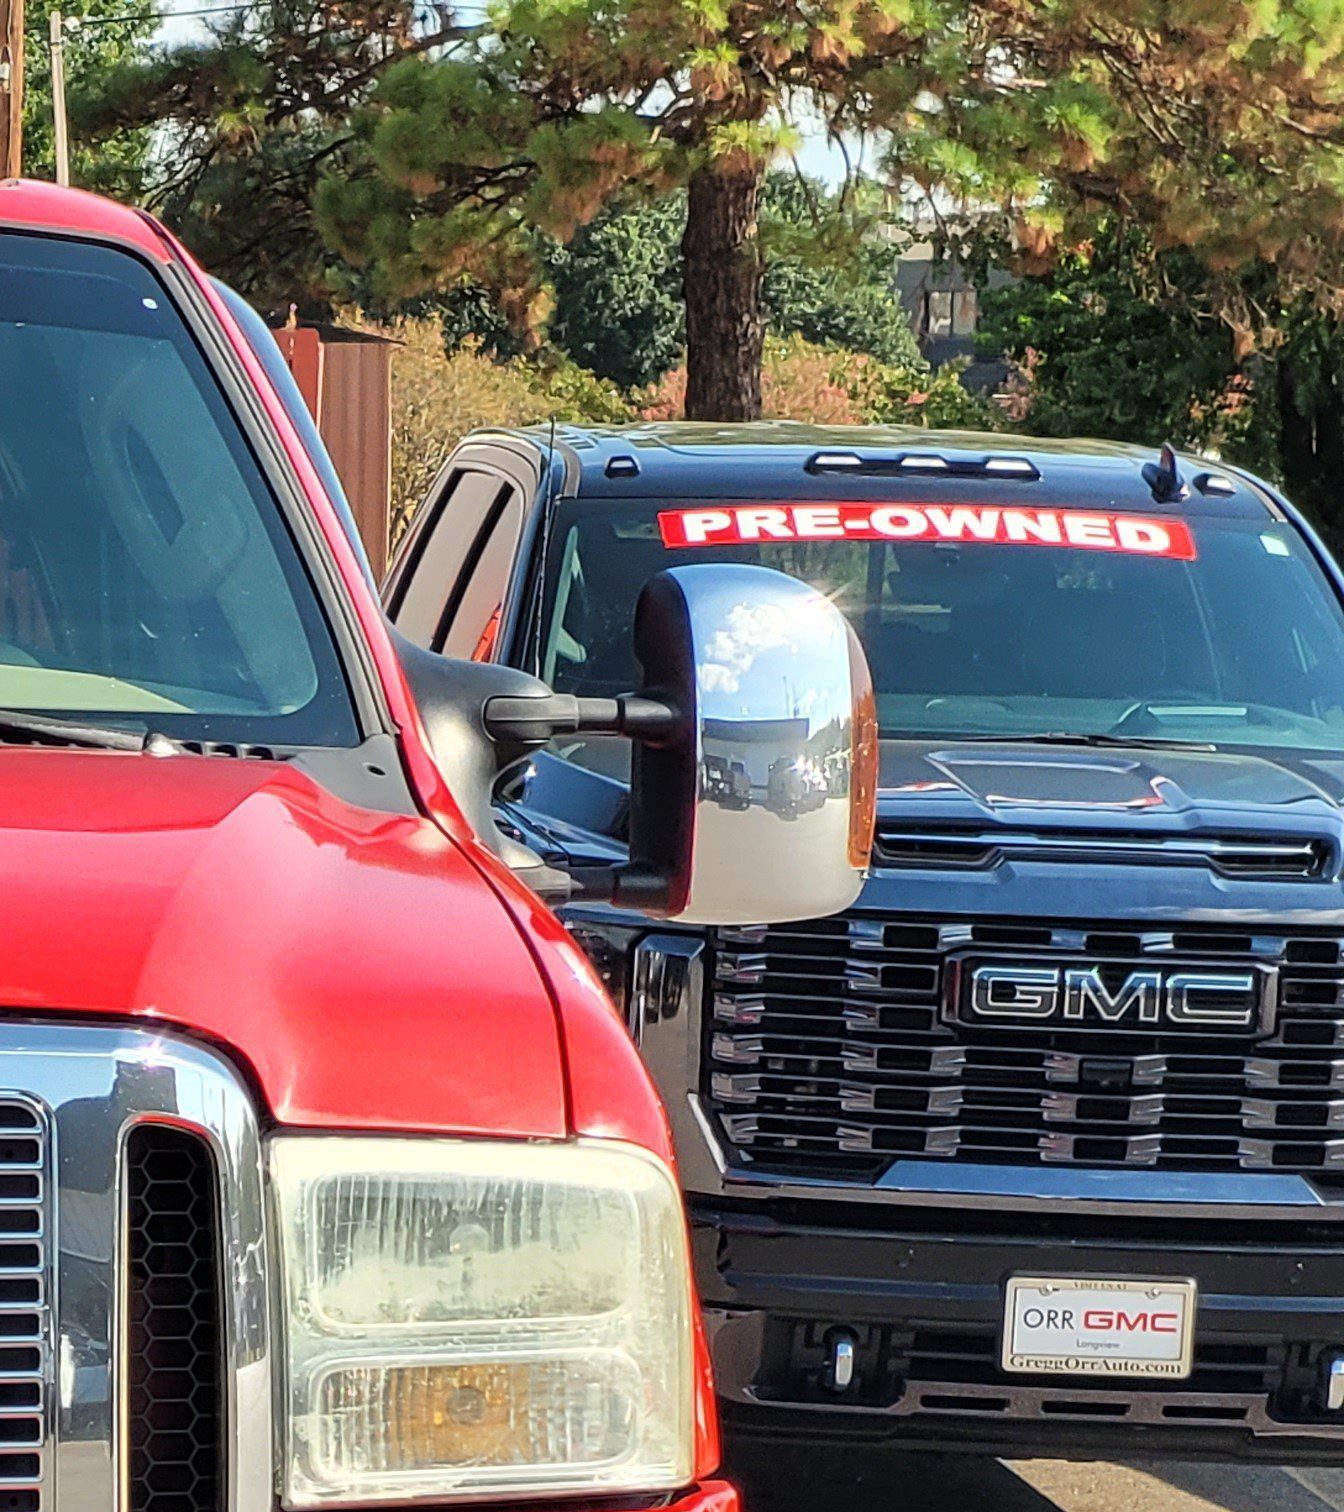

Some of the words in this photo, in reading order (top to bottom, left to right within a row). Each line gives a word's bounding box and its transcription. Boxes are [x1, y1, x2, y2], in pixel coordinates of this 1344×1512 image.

[681, 507, 1170, 552] PRE-OWNED
[971, 966, 1253, 1025] GMC
[1023, 1308, 1074, 1330] ORR
[1083, 1310, 1178, 1332] GMC
[1076, 1338, 1120, 1350] Longview
[1009, 1355, 1182, 1374] GreggOrrAuto.com
